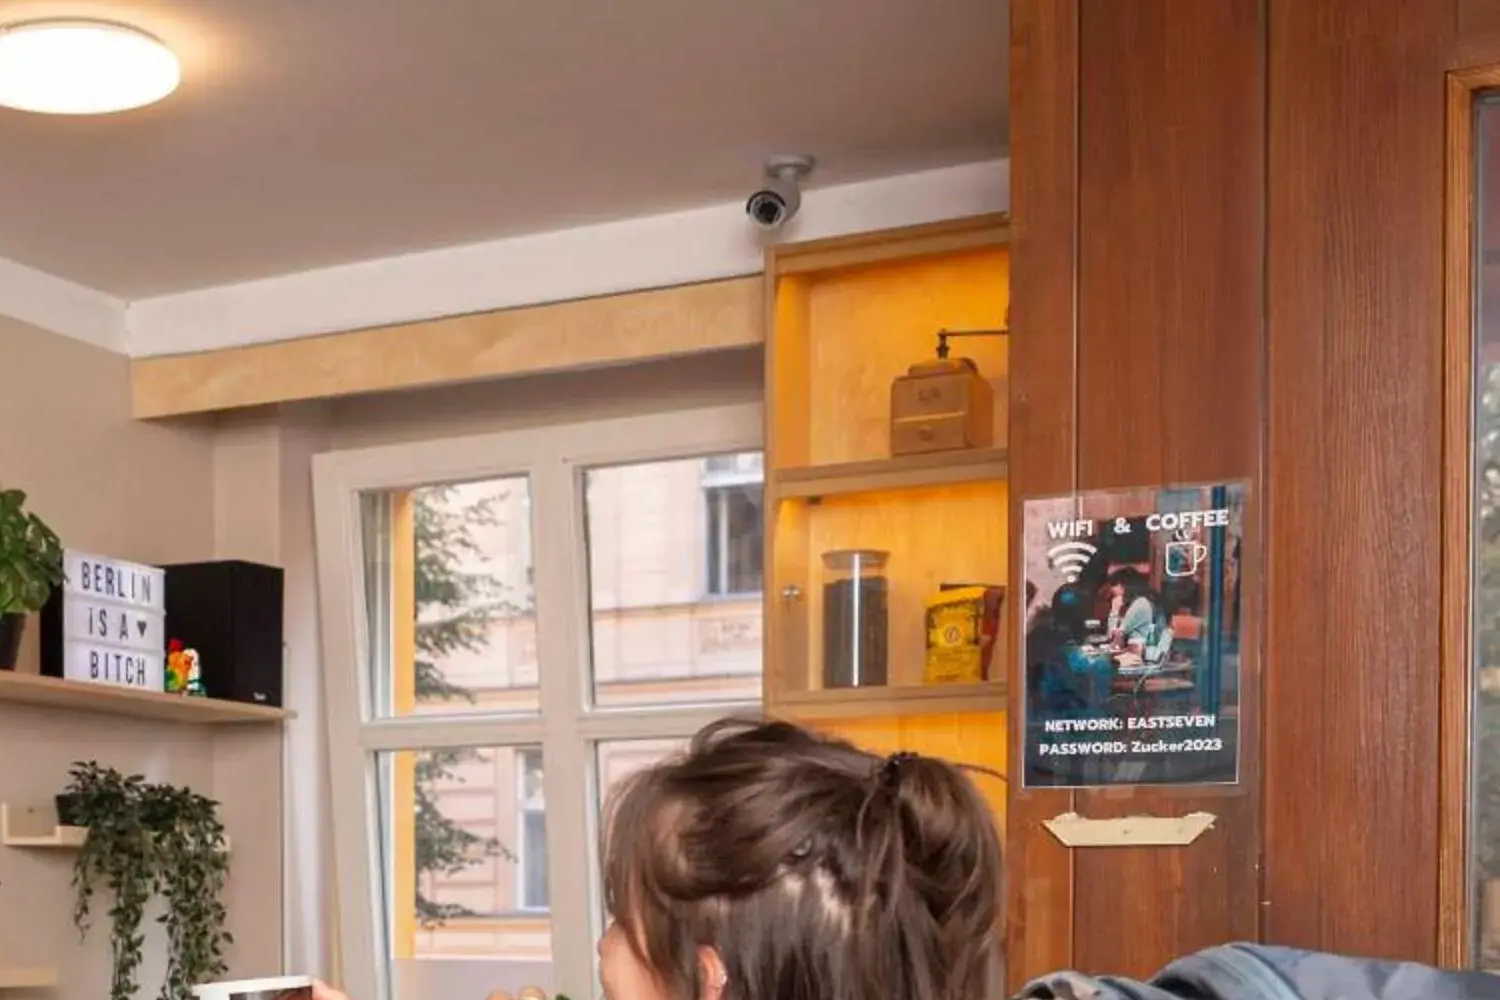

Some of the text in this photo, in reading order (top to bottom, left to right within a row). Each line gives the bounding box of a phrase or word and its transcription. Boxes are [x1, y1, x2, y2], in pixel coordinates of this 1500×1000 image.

[1048, 508, 1229, 539] WIFI & COFFEE
[82, 561, 151, 602] BERLIN
[119, 613, 129, 640] A
[90, 651, 146, 685] BITCH
[1044, 714, 1216, 733] NETWORK: EASTSEVEN
[1039, 738, 1223, 756] PASSWORD: Zucker2023
